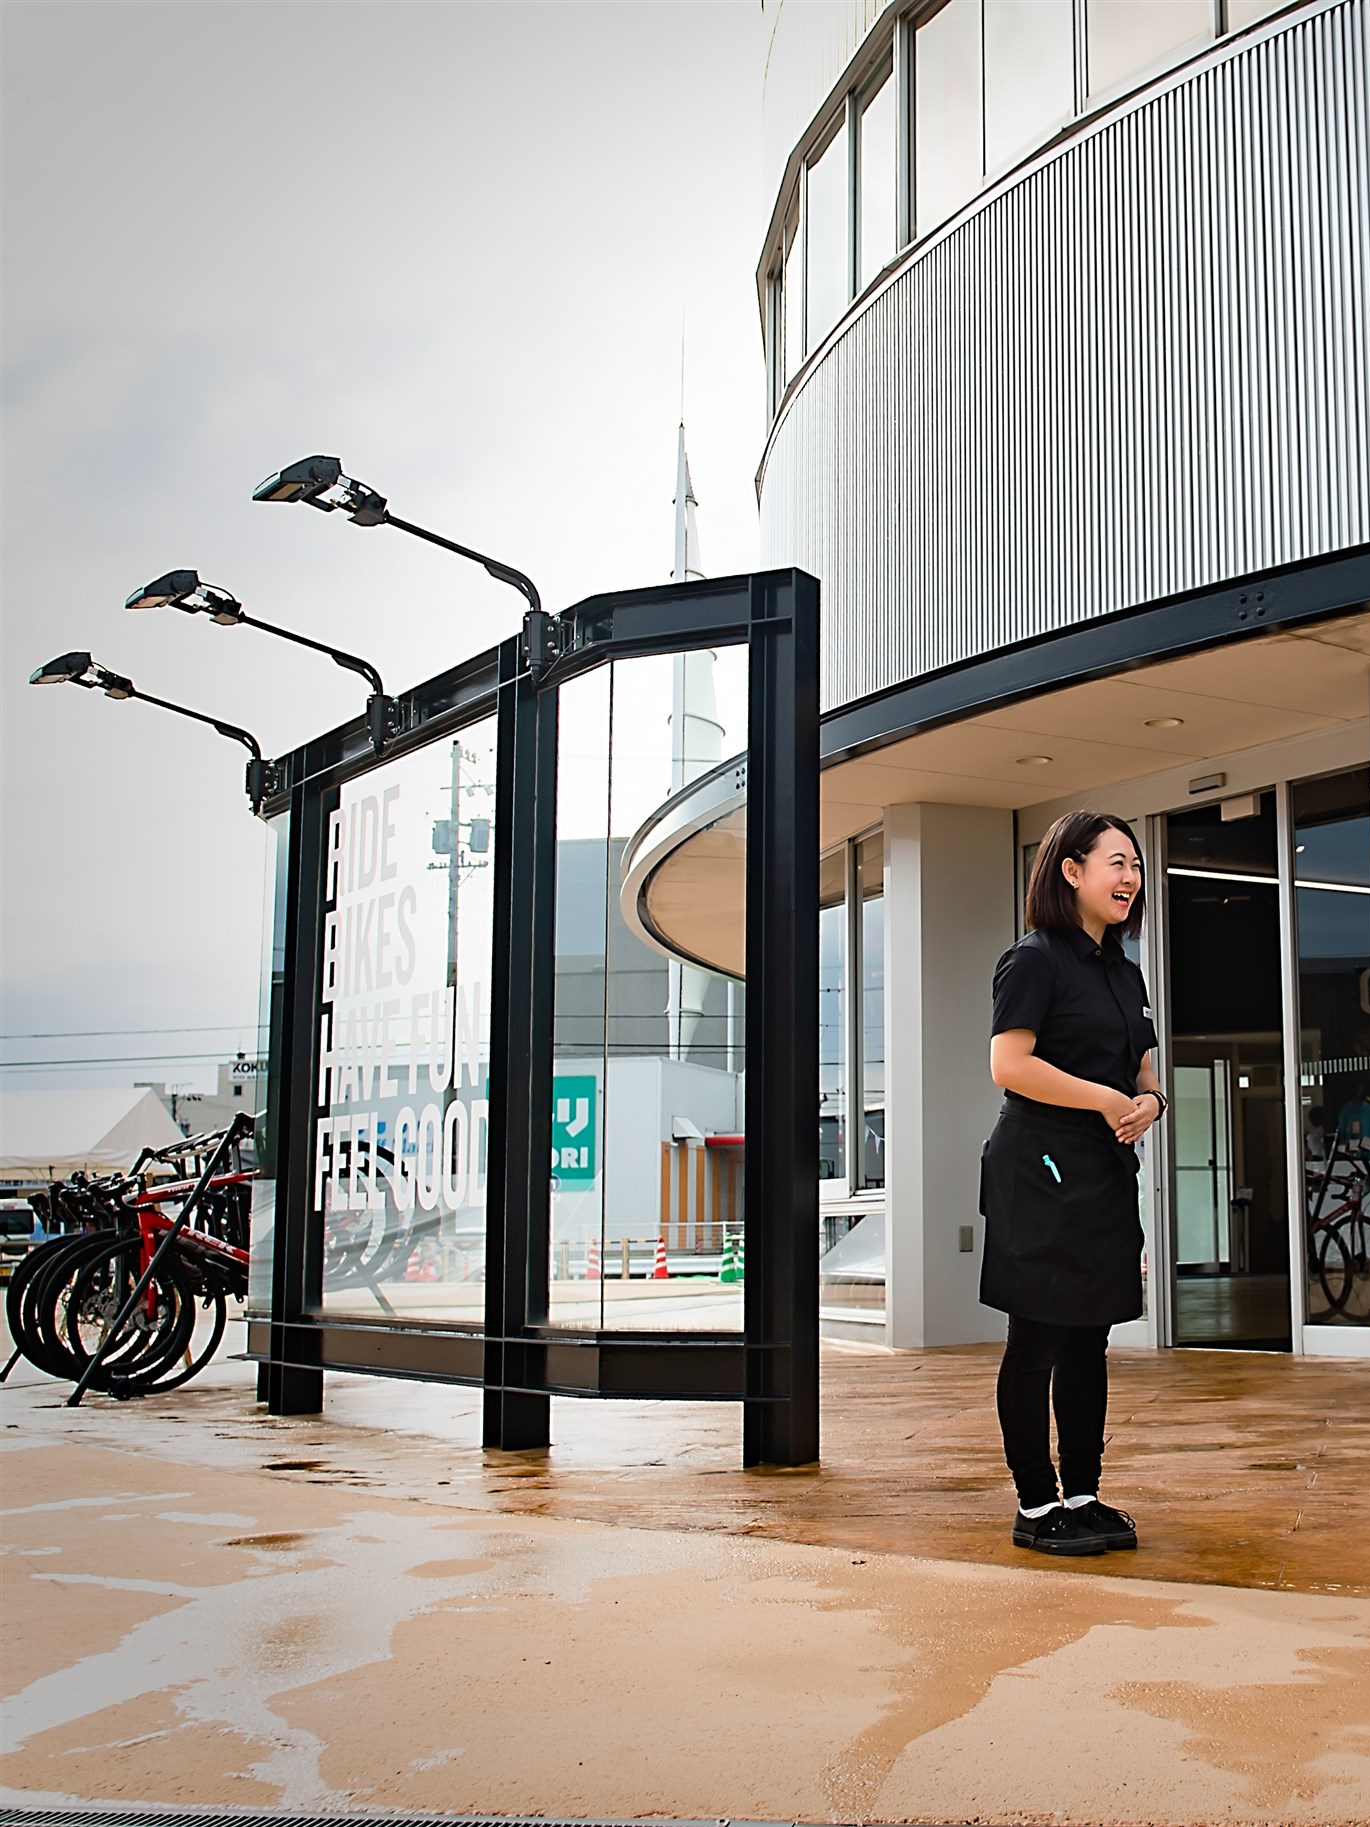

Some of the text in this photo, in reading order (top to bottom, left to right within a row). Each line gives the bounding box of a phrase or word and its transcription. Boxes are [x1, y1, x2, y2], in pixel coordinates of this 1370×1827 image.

[326, 784, 400, 901] RIDE
[322, 885, 417, 1004] BIKES
[318, 981, 481, 1107] HAVE FUN
[314, 1099, 489, 1212] FEEL GOOD
